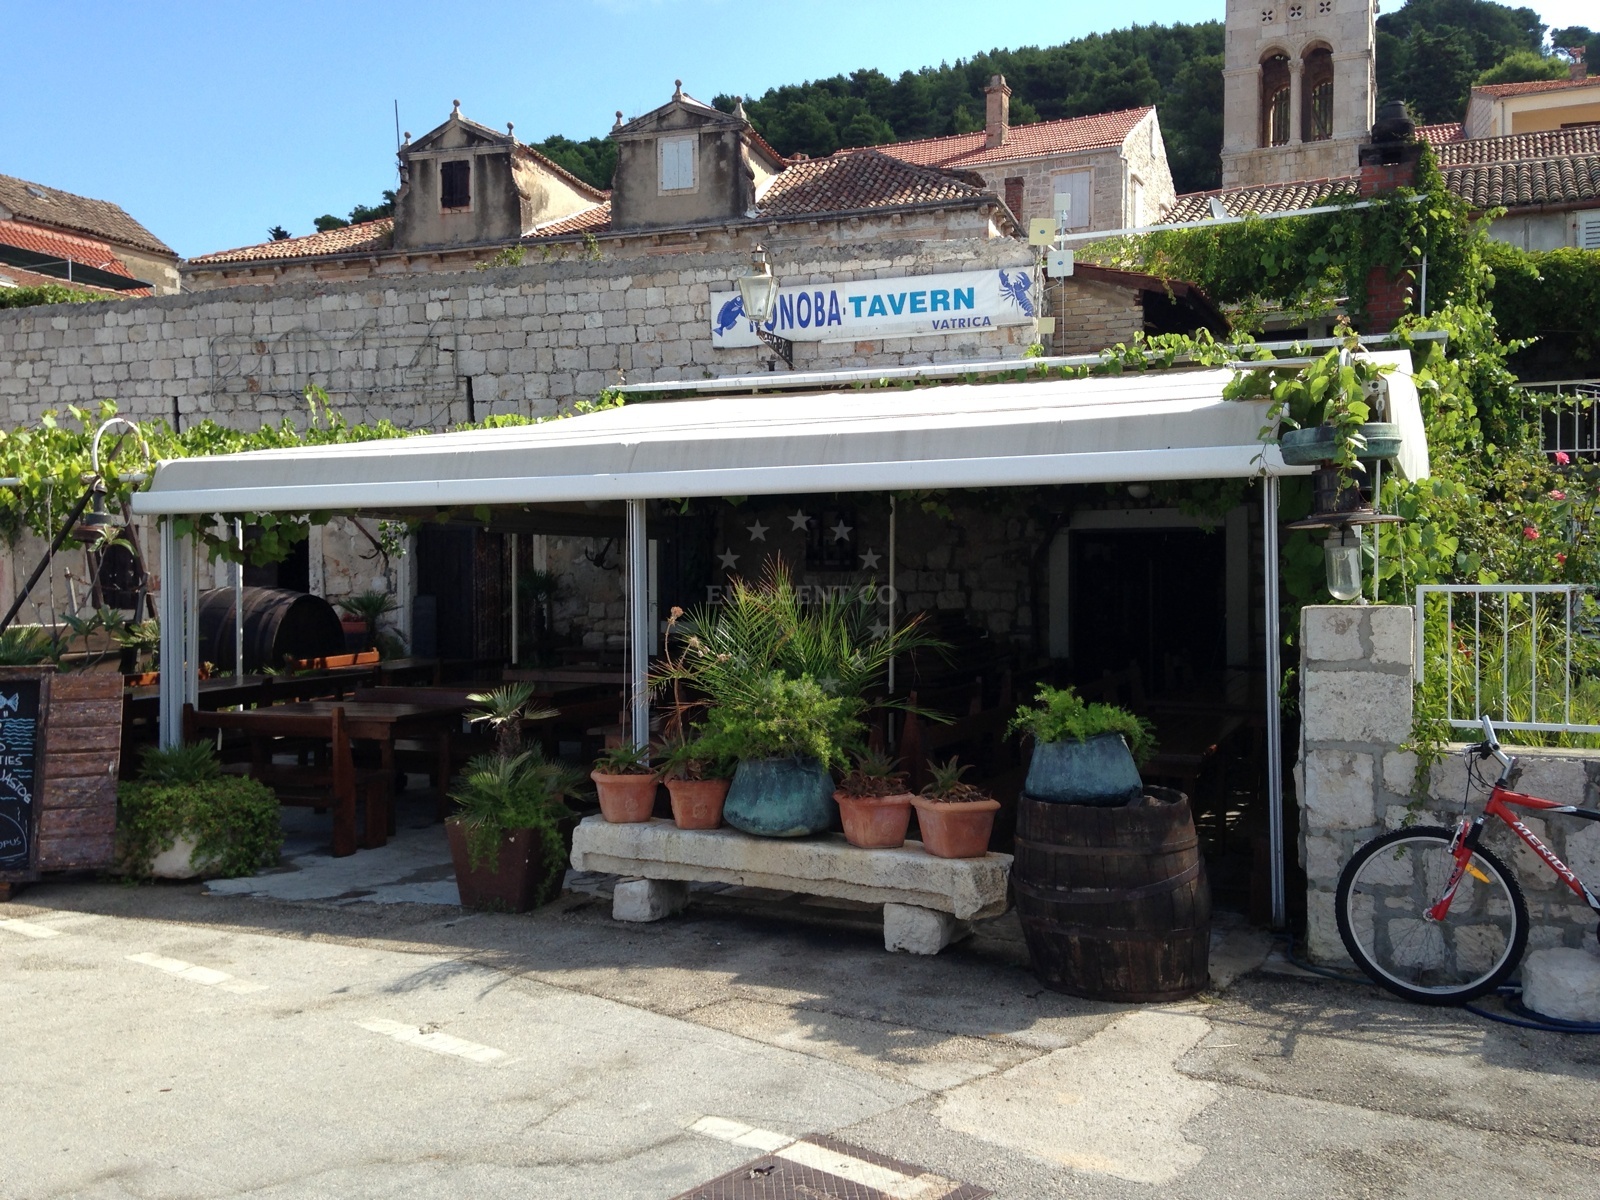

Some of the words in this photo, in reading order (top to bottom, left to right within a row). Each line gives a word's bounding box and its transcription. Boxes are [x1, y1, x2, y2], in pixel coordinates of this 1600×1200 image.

[848, 287, 975, 318] TAVERN
[932, 316, 991, 330] VATRICA
[1512, 821, 1575, 882] MERIDA
